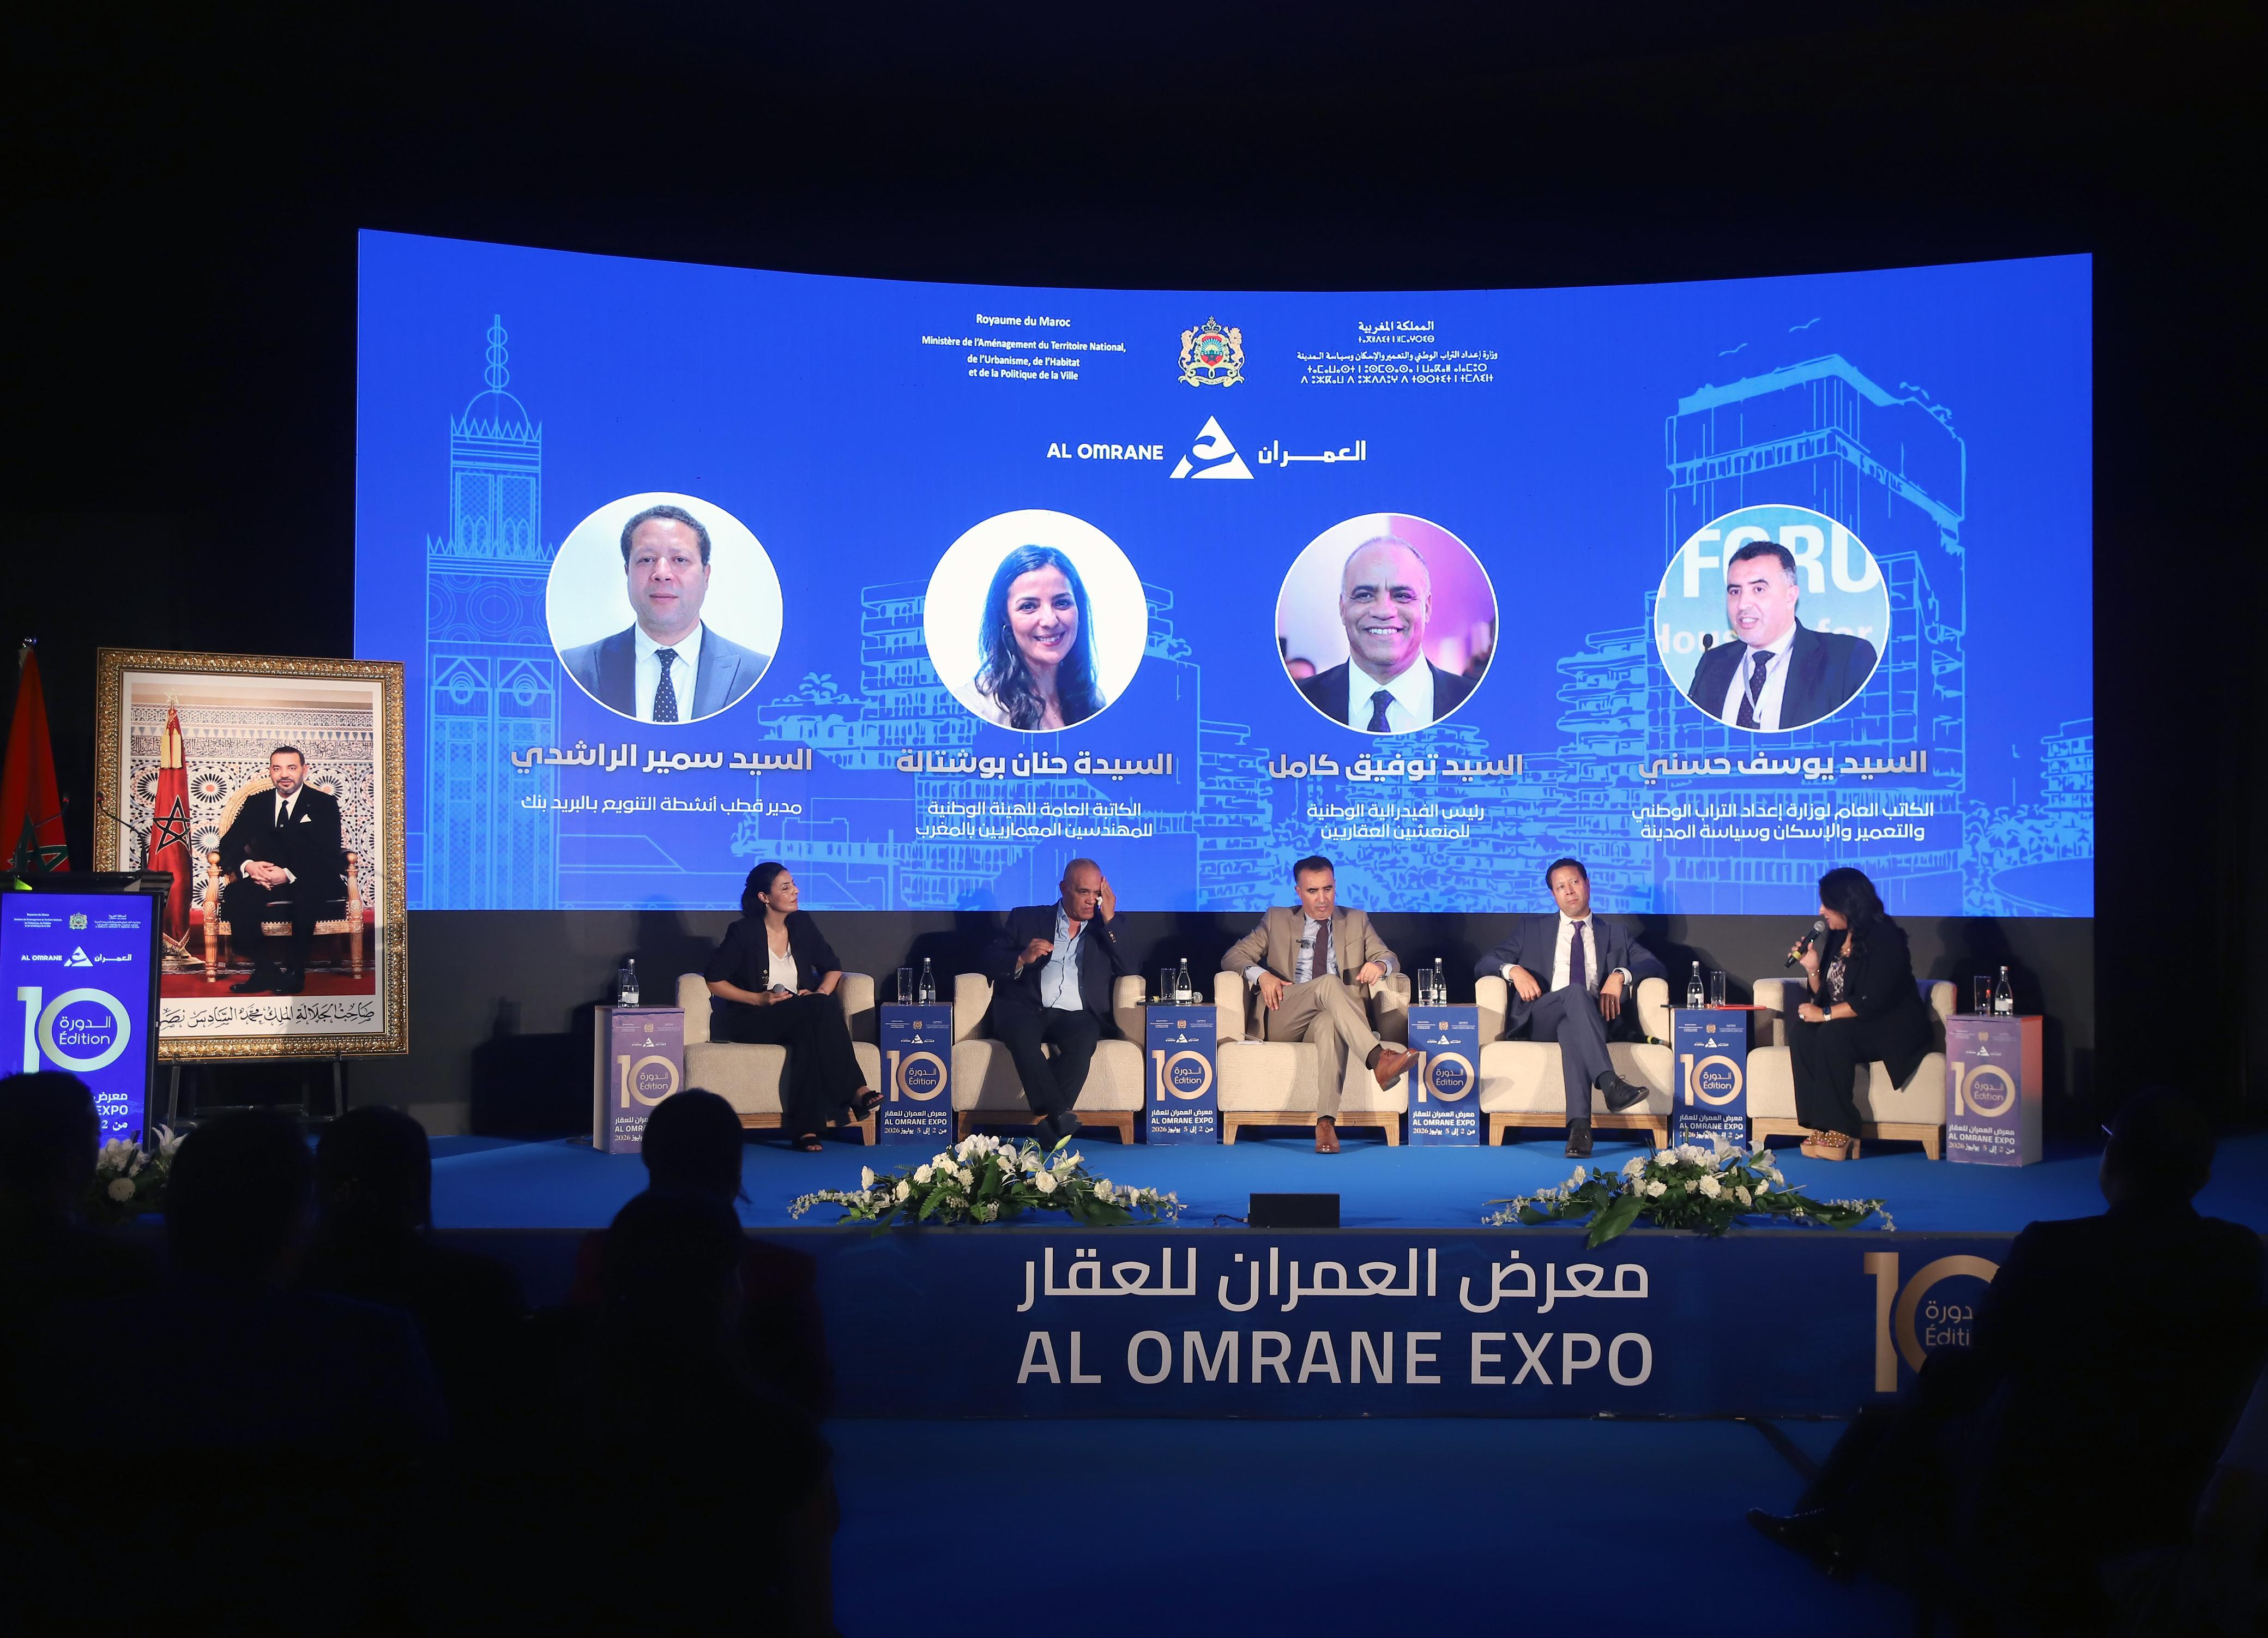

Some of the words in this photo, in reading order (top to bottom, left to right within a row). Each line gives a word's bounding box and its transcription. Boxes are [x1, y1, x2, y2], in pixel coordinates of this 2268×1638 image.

[977, 314, 1021, 326] Royaume
[1024, 316, 1036, 326] du
[1040, 317, 1070, 327] Maroc
[1359, 321, 1394, 334] المغربية
[1397, 321, 1434, 330] المملكة
[922, 336, 960, 345] Ministère
[962, 338, 973, 346] de
[1039, 341, 1048, 349] du
[1051, 341, 1088, 350] Territoire
[1090, 342, 1126, 352] National,
[968, 354, 978, 363] de
[1033, 357, 1043, 365] de
[1326, 352, 1354, 361] وسياسة
[1355, 351, 1385, 361] والإسكان
[1385, 352, 1413, 361] والتعمير
[1415, 351, 1438, 363] الوطني
[1440, 351, 1459, 360] التراب
[1461, 351, 1481, 360] إعداد
[1483, 351, 1498, 360] وزارة
[979, 368, 989, 377] de
[992, 369, 998, 377] la
[1001, 370, 1037, 380] Politique
[1039, 371, 1049, 379] de
[1051, 371, 1058, 379] la
[1060, 371, 1078, 380] Ville
[1047, 443, 1072, 458] AL
[1078, 444, 1163, 460] OMRANE
[512, 740, 636, 773] الراشدي
[643, 751, 722, 773] سمير
[729, 749, 811, 775] السيد
[897, 749, 1005, 779] بوشتالة
[1012, 752, 1067, 776] حنان
[1075, 751, 1172, 780] السيدة
[1269, 755, 1338, 778] كامل
[1346, 754, 1438, 781] توفيق
[1443, 755, 1522, 781] السيد
[1639, 753, 1730, 784] حسني
[1738, 752, 1833, 780] يوسف
[1841, 751, 1926, 779] السيد
[522, 794, 546, 808] بنك
[551, 796, 598, 812] بالبريد
[602, 797, 655, 813] التنويع
[661, 796, 716, 811] أنشطة
[721, 798, 763, 815] قطب
[766, 803, 801, 816] مدير
[928, 802, 985, 818] الوطنية
[990, 802, 1035, 818] للهيئة
[1040, 803, 1088, 817] العامة
[1093, 803, 1141, 819] الكاتبة
[1307, 804, 1364, 820] الوطنية
[1368, 804, 1438, 821] الفيدرالية
[1442, 804, 1483, 820] رئيس
[1632, 804, 1691, 822] الوطني
[1696, 804, 1736, 821] التراب
[1741, 804, 1782, 821] إعداد
[1787, 803, 1830, 820] لوزارة
[1835, 803, 1878, 820] العام
[1883, 803, 1933, 820] الكاتب
[916, 822, 974, 838] بالمغرب
[979, 822, 1060, 839] المعماريين
[1065, 823, 1152, 839] للمهندسين
[1322, 824, 1389, 840] العقاريين
[1394, 824, 1469, 840] للمنعشين
[1641, 824, 1695, 841] المدينة
[1700, 824, 1769, 841] وسياسة
[1774, 823, 1851, 841] والإسكان
[1855, 824, 1924, 841] والتعمير
[59, 1032, 110, 1045] Édition
[909, 1076, 936, 1085] Édition
[1704, 1080, 1731, 1089] Édition
[1974, 1091, 2004, 1100] Édition
[101, 1120, 108, 1129] 2
[112, 1122, 128, 1131] من
[1017, 1248, 1196, 1311] للعقار
[1219, 1248, 1436, 1311] العمران
[1459, 1250, 1648, 1313] معرض
[1926, 1324, 1969, 1346] Éditi
[1017, 1332, 1101, 1383] AL
[1128, 1330, 1441, 1384] OMRANE
[1471, 1333, 1652, 1386] EXPO
